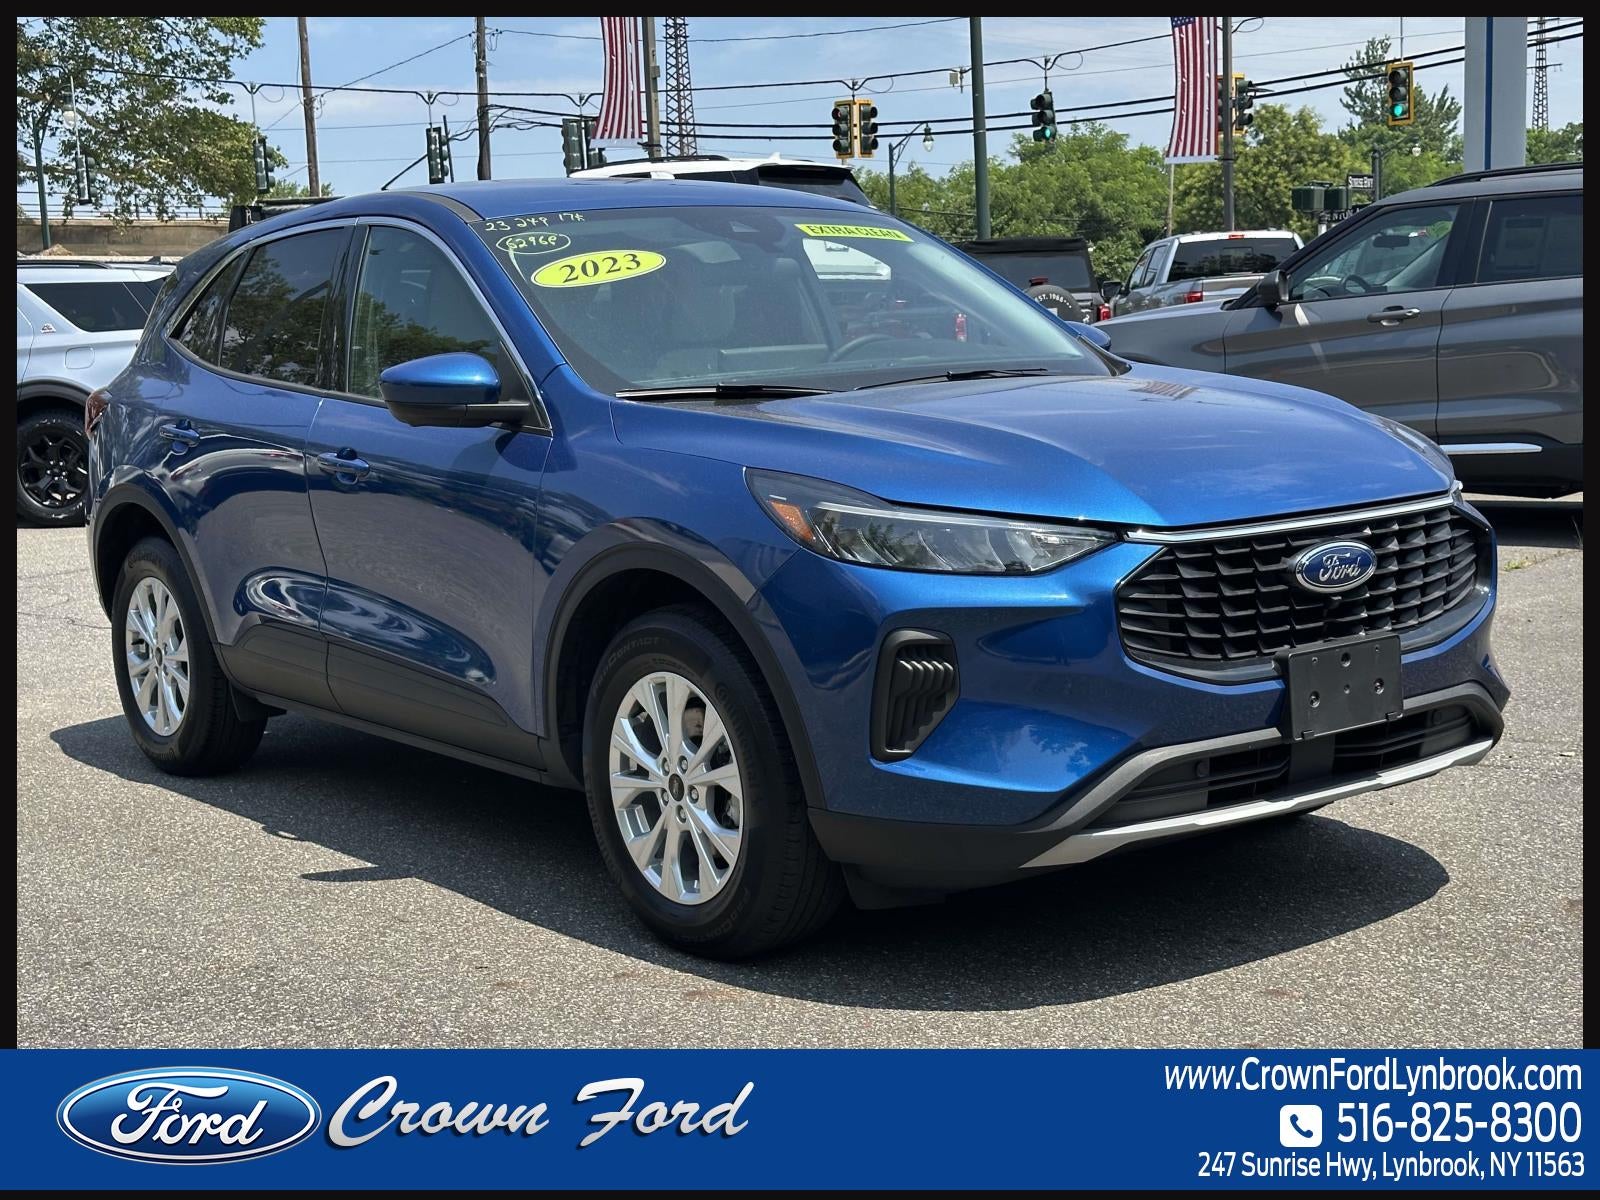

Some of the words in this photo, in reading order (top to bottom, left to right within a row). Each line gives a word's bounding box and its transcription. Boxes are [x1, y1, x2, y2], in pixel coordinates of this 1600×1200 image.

[484, 220, 511, 231] 23
[806, 225, 854, 235] EXTRA
[854, 227, 902, 239] CLEAN
[559, 253, 642, 284] 2023
[1318, 552, 1361, 582] Ford
